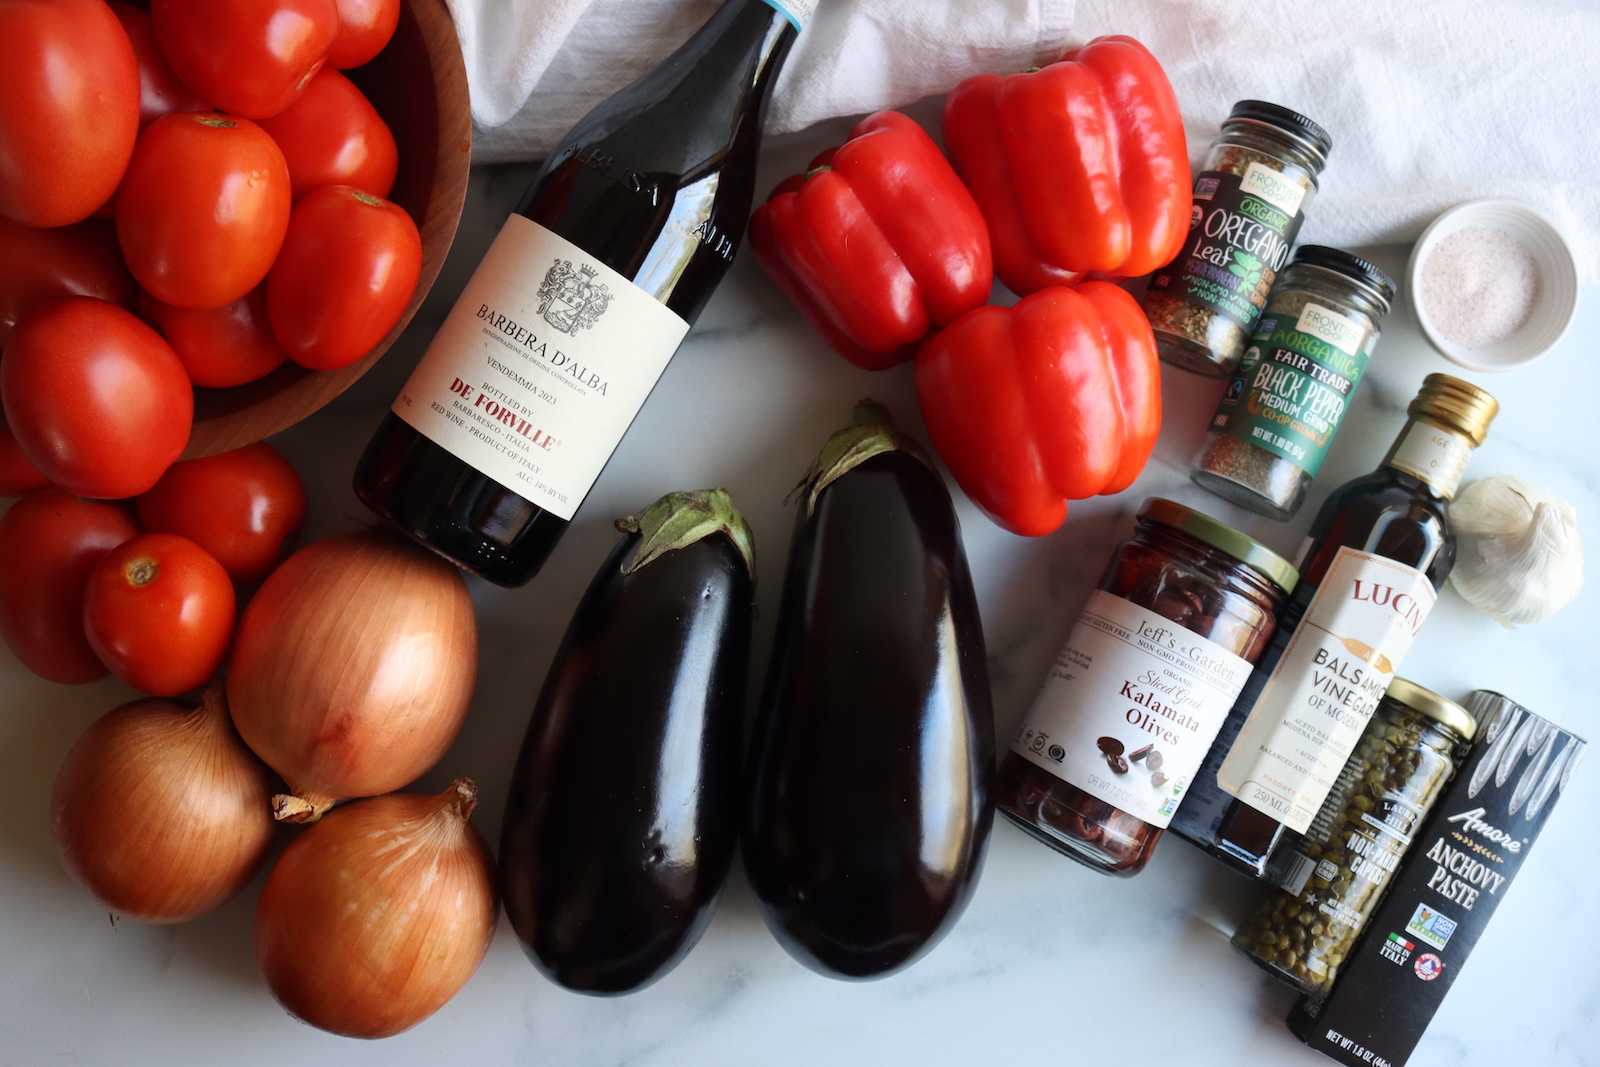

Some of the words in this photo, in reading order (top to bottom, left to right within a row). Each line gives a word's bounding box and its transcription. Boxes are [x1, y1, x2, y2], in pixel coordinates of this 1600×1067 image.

[1248, 170, 1297, 200] FRONTIER
[1260, 185, 1285, 202] CO-OP
[1238, 198, 1288, 229] ORGANIC
[1193, 235, 1235, 270] Leaf
[1204, 208, 1288, 272] OREGANO
[1184, 255, 1240, 290] MEDITERRANEAN
[1192, 274, 1228, 297] NON-GMO
[1195, 289, 1253, 324] NON-IRRADIATED
[1306, 310, 1356, 340] FRONTIER
[1317, 325, 1344, 342] CO-OP
[477, 305, 546, 356] BARBERA
[551, 351, 608, 395] D'ALBA
[482, 328, 521, 354] DENOMINAZIONE
[528, 356, 549, 372] ORIGINE
[550, 371, 586, 395] CONTROLLATA
[1284, 329, 1355, 373] ORGANIC
[488, 357, 536, 393] VENDEMMIA
[538, 390, 556, 405] 2023
[1276, 348, 1309, 372] FAIR
[1307, 363, 1351, 392] TRADE
[482, 382, 519, 409] BOTTLED
[520, 407, 533, 417] BY
[1253, 359, 1304, 403] BLACK
[1299, 382, 1347, 424] PEPPER
[450, 378, 474, 400] DE
[475, 394, 551, 448] FORVILLE
[453, 401, 501, 432] BARBARESCO
[505, 434, 530, 452] ITALIA
[1258, 389, 1301, 418] MEDIUM
[1300, 410, 1330, 433] GRIND
[1262, 406, 1289, 426] CO-OP
[1288, 419, 1318, 439] GROWN
[430, 401, 446, 414] RED
[445, 411, 464, 427] WINE
[469, 427, 506, 452] PRODUCT
[506, 450, 518, 460] OF
[518, 457, 540, 474] ITALY
[1251, 425, 1264, 438] NET
[534, 481, 547, 492] 14%
[547, 488, 558, 498] BY
[1093, 616, 1114, 632] GLUTEN
[1113, 627, 1130, 639] FREE
[1138, 639, 1174, 660] NON-GMO
[1175, 658, 1203, 676] PROJECT
[1203, 673, 1229, 690] VERIFIED
[1136, 620, 1176, 650] Jeff's
[1187, 647, 1233, 679] Garden
[1137, 668, 1176, 696] Sliced
[1172, 687, 1204, 713] Greek
[1163, 669, 1193, 687] ORGANIC
[1312, 648, 1388, 700] BALSAMIC
[1120, 681, 1198, 730] Kalamata
[1307, 694, 1326, 710] OF
[1325, 704, 1358, 730] MODENA
[1309, 671, 1376, 719] VINEGAR
[1126, 708, 1179, 743] Olives
[1282, 720, 1311, 738] MODENA
[1311, 736, 1324, 746] IGP
[1294, 718, 1315, 732] ACETO
[1259, 745, 1292, 765] BALANCED
[1293, 764, 1307, 774] AND
[1087, 774, 1099, 785] DR
[1099, 780, 1110, 791] WT
[1110, 785, 1122, 797] 7.0
[1121, 791, 1131, 802] OZ
[1254, 788, 1270, 804] 250
[1268, 797, 1282, 812] ML
[1381, 800, 1417, 825] LAUREL
[1382, 813, 1409, 832] HILL
[1448, 807, 1521, 854] Amore
[1317, 868, 1332, 878] GMO
[1321, 861, 1335, 872] NON
[1349, 855, 1386, 885] CAPERS
[1426, 838, 1506, 899] ANCHOVY
[1427, 865, 1480, 911] PASTE
[1409, 922, 1445, 944] VERIFIED
[1433, 921, 1450, 934] GMO
[1437, 917, 1453, 929] NON
[1379, 946, 1406, 966] ITALY
[1383, 938, 1403, 952] MADE
[1401, 948, 1411, 957] IN
[1326, 1029, 1342, 1044] NET
[1340, 1037, 1354, 1050] WT
[1352, 1044, 1364, 1057] 1.6
[1362, 1050, 1374, 1062] OZ
